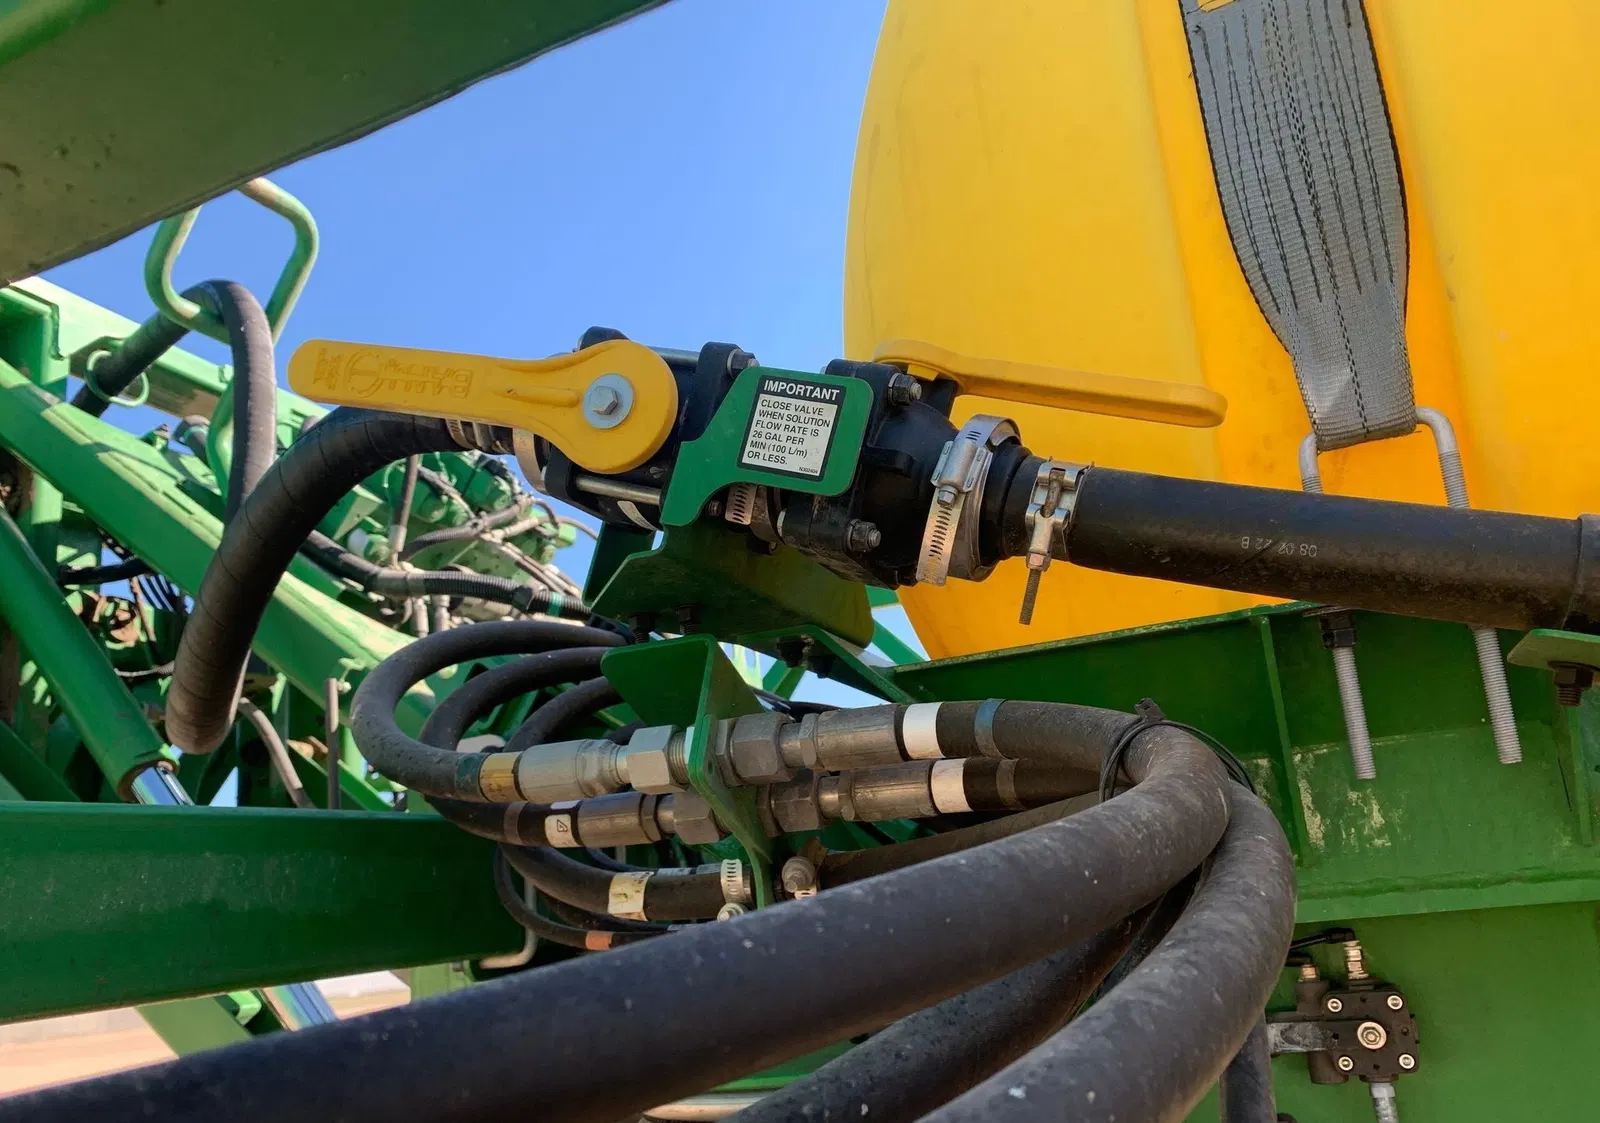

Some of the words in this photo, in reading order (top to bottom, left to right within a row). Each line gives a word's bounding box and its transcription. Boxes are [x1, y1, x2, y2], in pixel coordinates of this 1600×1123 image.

[763, 380, 840, 401] IMPORTANT
[761, 399, 792, 411] CLOSE
[794, 404, 824, 416] VALVE
[758, 409, 785, 420] WHEN
[786, 413, 831, 428] SOLUTION
[755, 420, 782, 431] FLOW
[783, 425, 808, 435] RATE
[810, 428, 820, 437] IS
[752, 430, 763, 439] 26
[764, 433, 783, 443] GAL
[785, 436, 805, 446] PER
[747, 450, 760, 460] OR
[762, 454, 788, 465] LESS.
[749, 440, 767, 450] MIN
[767, 443, 786, 454] (100
[788, 448, 808, 459] L/m)
